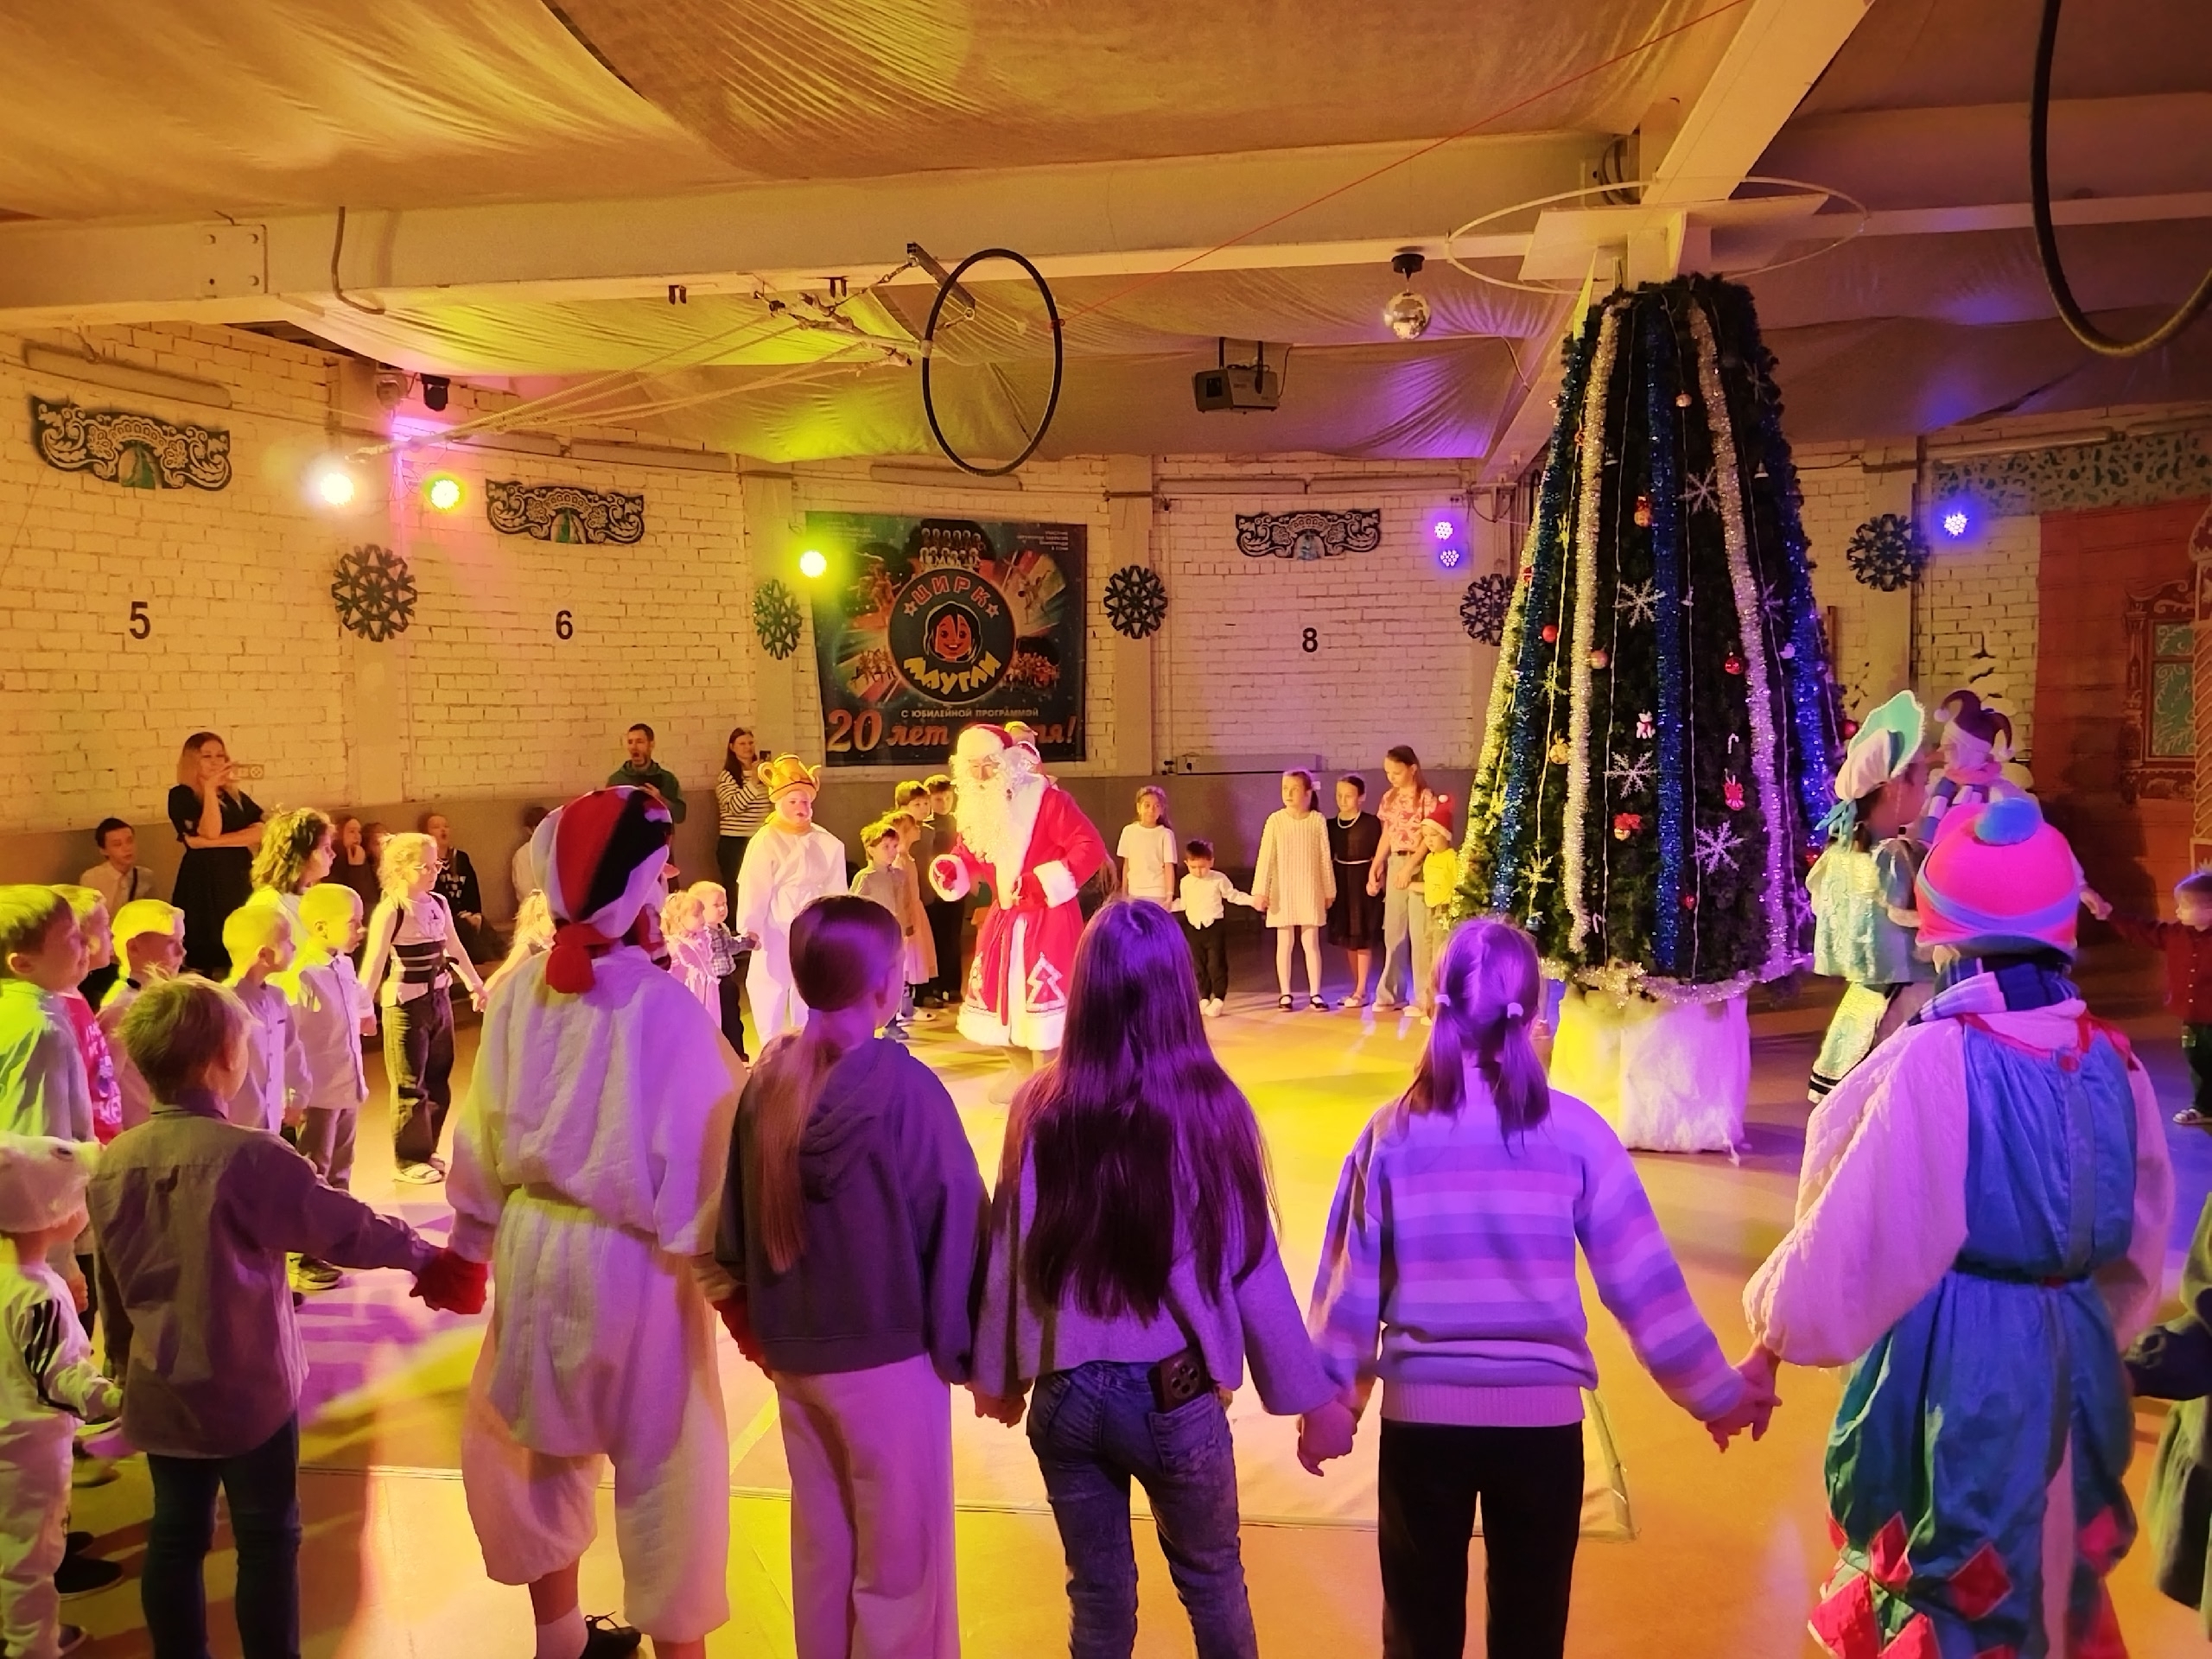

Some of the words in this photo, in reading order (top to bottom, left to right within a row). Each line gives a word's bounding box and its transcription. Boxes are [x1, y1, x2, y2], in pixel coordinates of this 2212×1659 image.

[911, 575, 991, 608] ЦИРК
[129, 601, 151, 640] 5
[556, 610, 574, 640] 6
[1302, 627, 1319, 653] 8
[900, 709, 909, 719] С
[911, 708, 973, 719] ЮБИЛЕЙНОЙ
[975, 707, 1039, 718] ПРОГРАММОЙ
[826, 709, 883, 753] 20
[885, 724, 950, 747] лет
